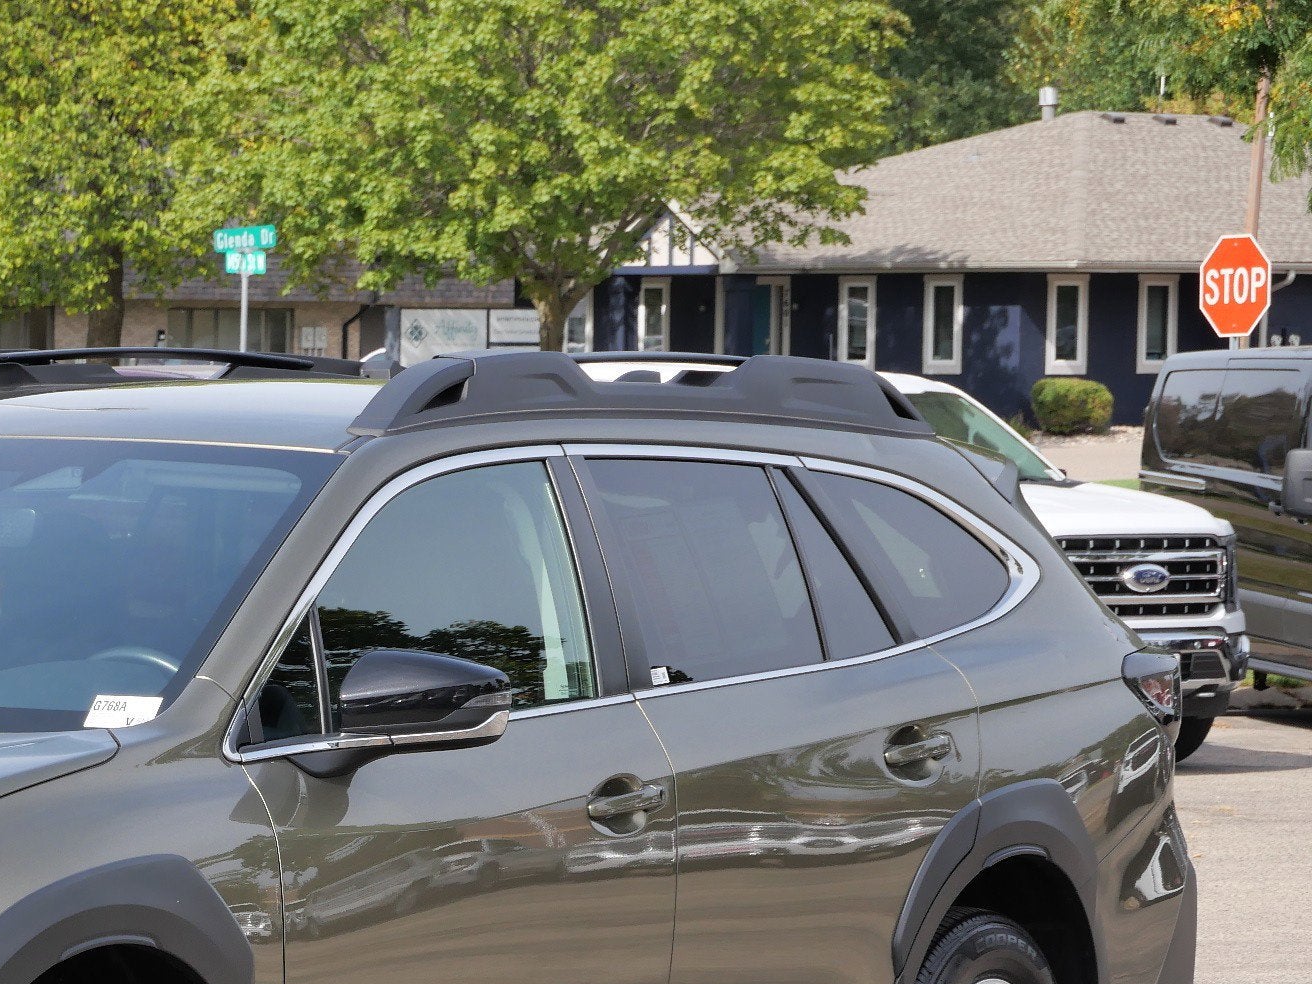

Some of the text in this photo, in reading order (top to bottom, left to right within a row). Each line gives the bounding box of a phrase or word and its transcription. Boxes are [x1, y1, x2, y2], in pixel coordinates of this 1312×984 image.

[216, 228, 275, 250] Glenda Dr
[1204, 266, 1267, 306] STOP
[93, 700, 128, 712] G768A
